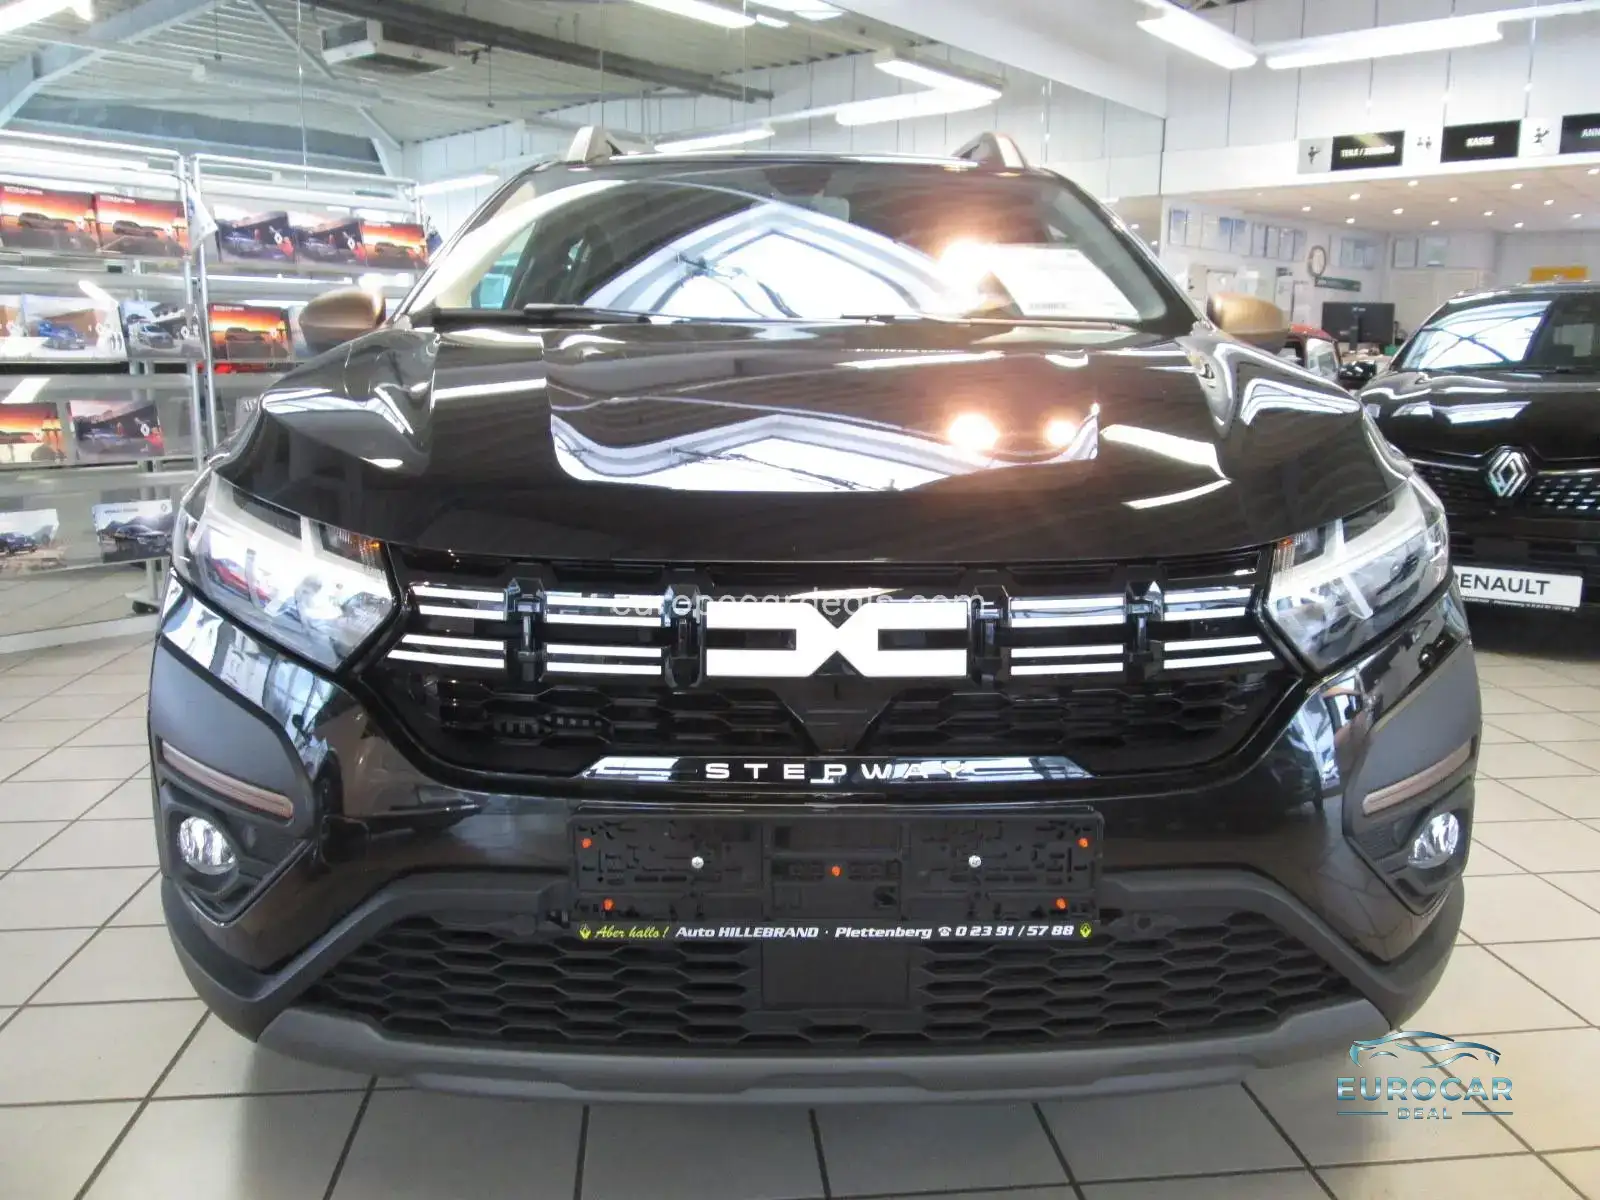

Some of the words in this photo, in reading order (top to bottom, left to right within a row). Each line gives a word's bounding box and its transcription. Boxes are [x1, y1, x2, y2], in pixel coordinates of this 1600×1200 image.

[1455, 573, 1550, 595] ENAULT
[705, 762, 967, 780] STEPWAY
[595, 925, 626, 939] Aber
[675, 927, 715, 938] Auto
[718, 927, 819, 938] HILLEBRAND
[834, 926, 932, 940] Plettenberg
